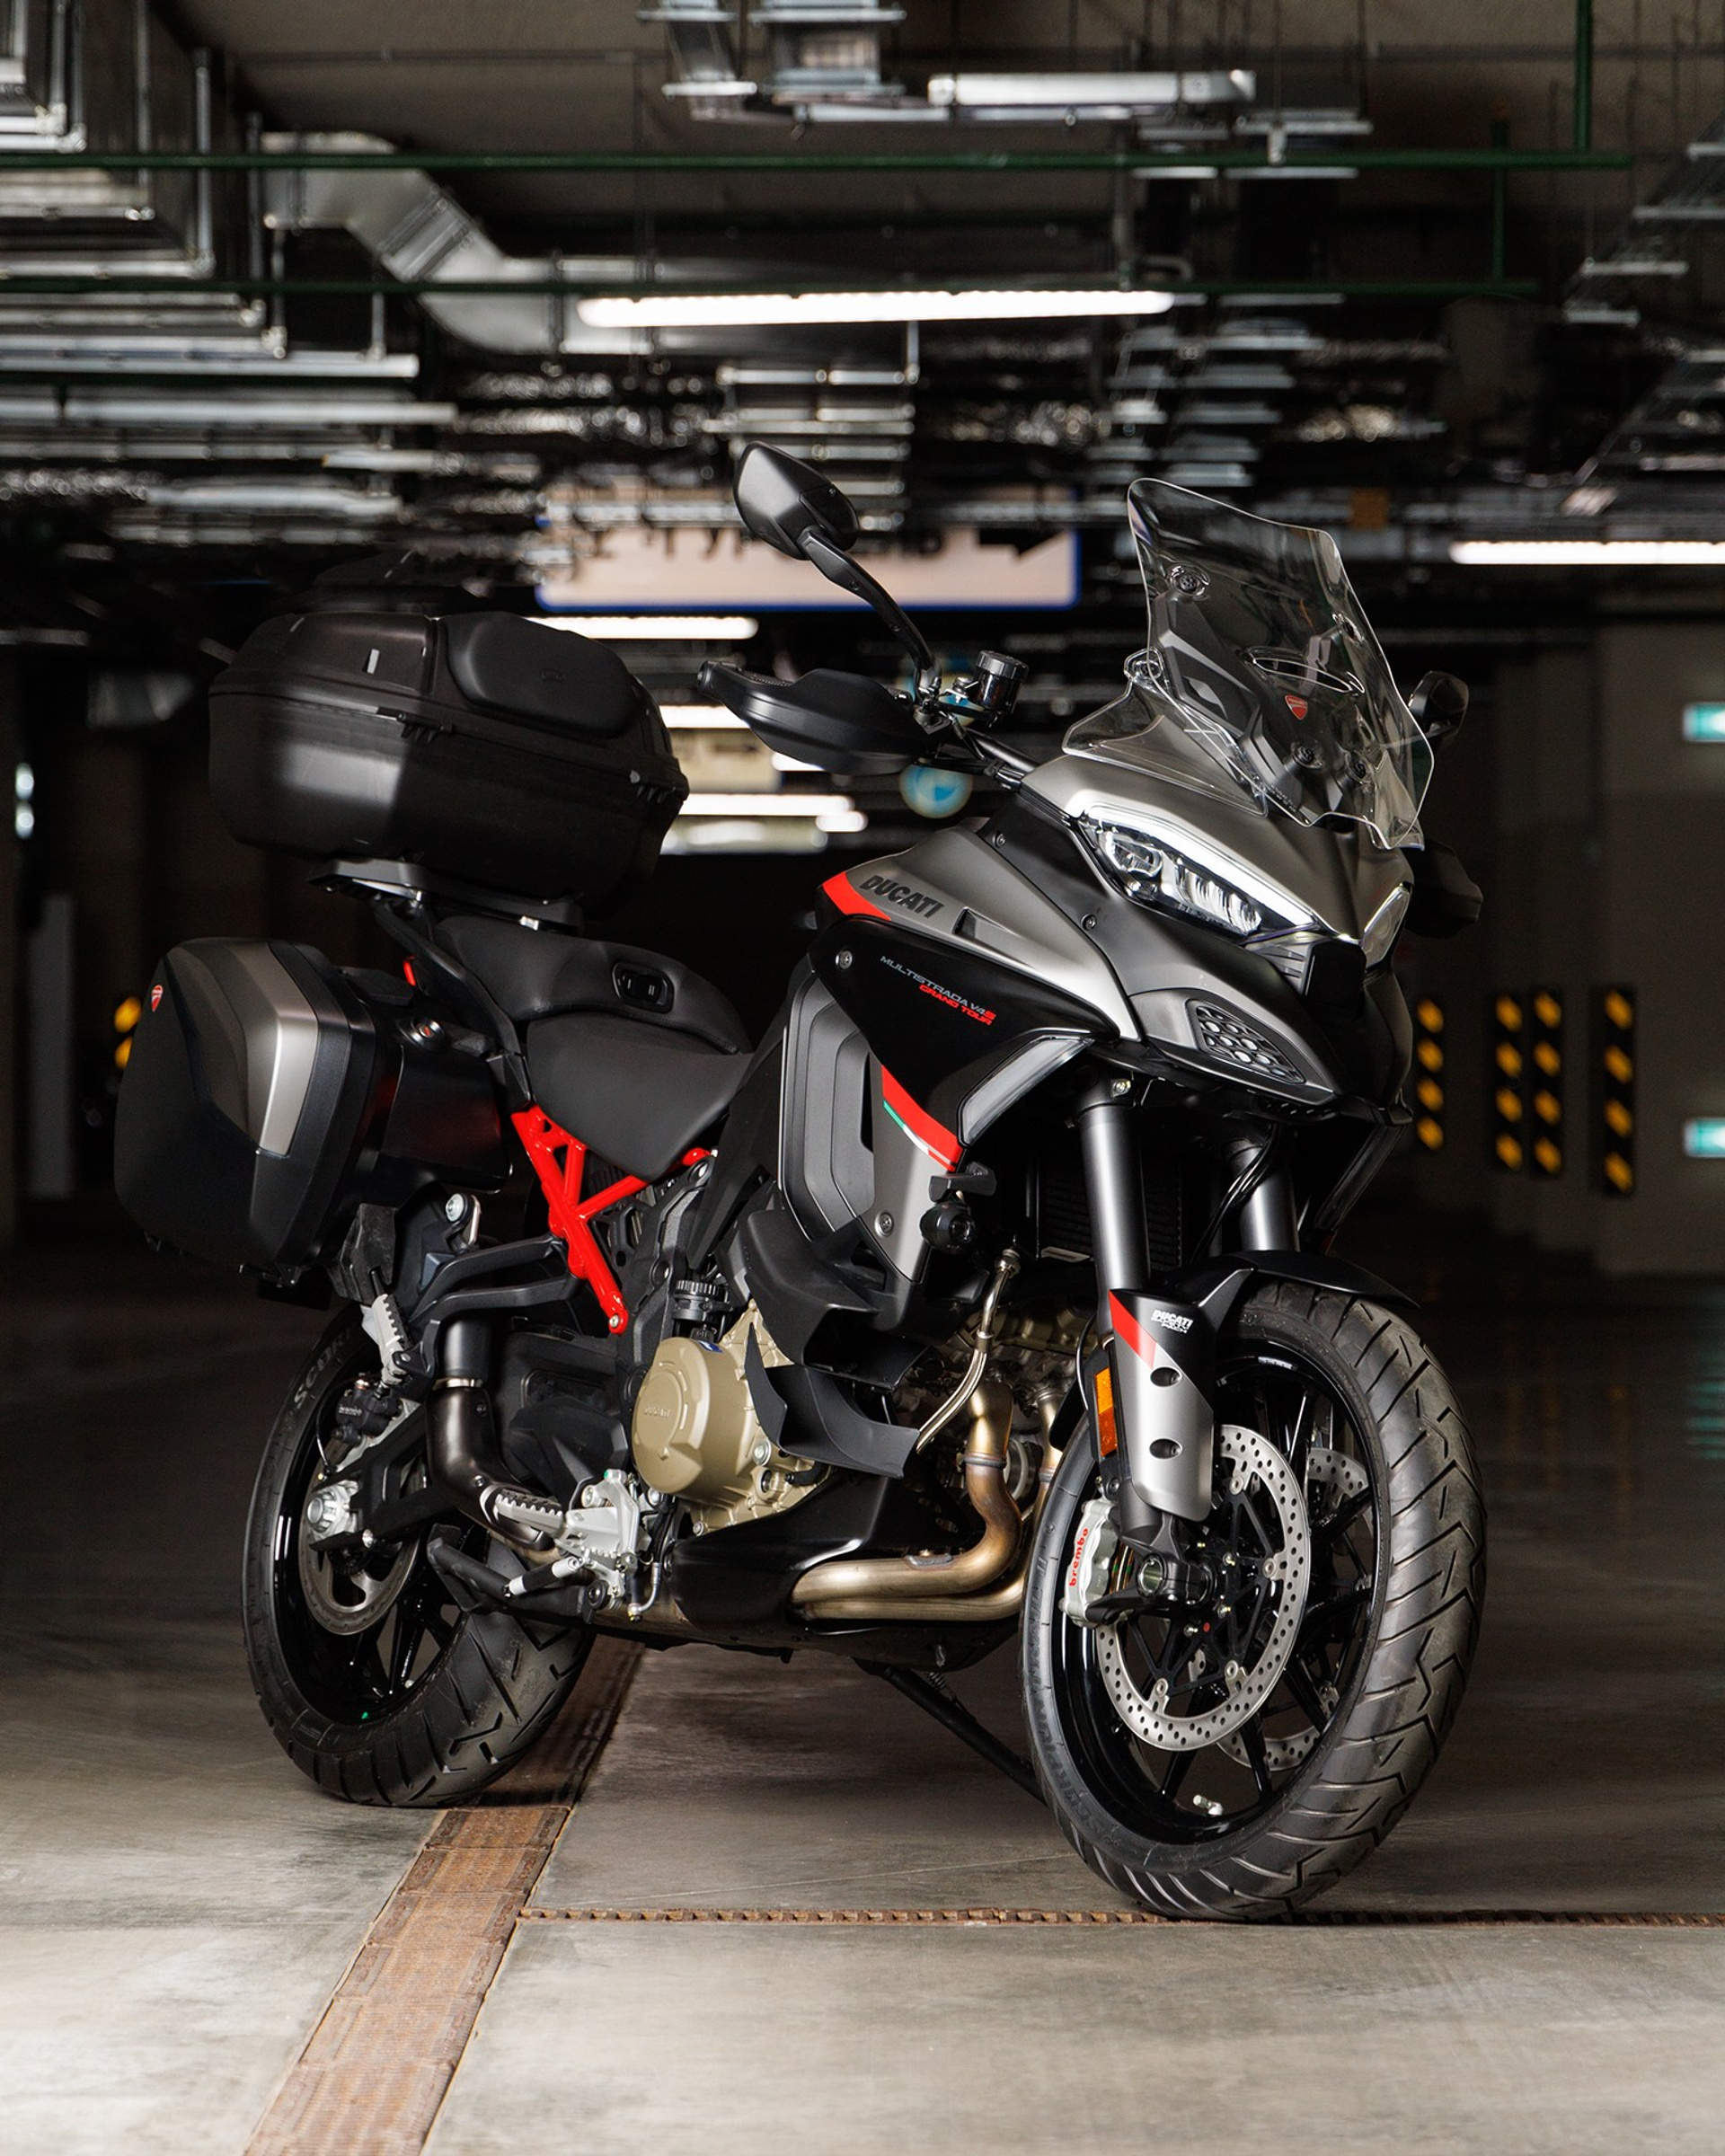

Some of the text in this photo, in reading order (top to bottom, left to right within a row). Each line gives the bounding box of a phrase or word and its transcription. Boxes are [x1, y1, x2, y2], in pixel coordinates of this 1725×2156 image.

[859, 874, 945, 918] DUCATI
[880, 956, 968, 1006] MULTISTRADA
[919, 984, 992, 1025] GRAND TOUR
[1153, 1309, 1194, 1329] DUCATI
[1069, 1528, 1088, 1586] brembo
